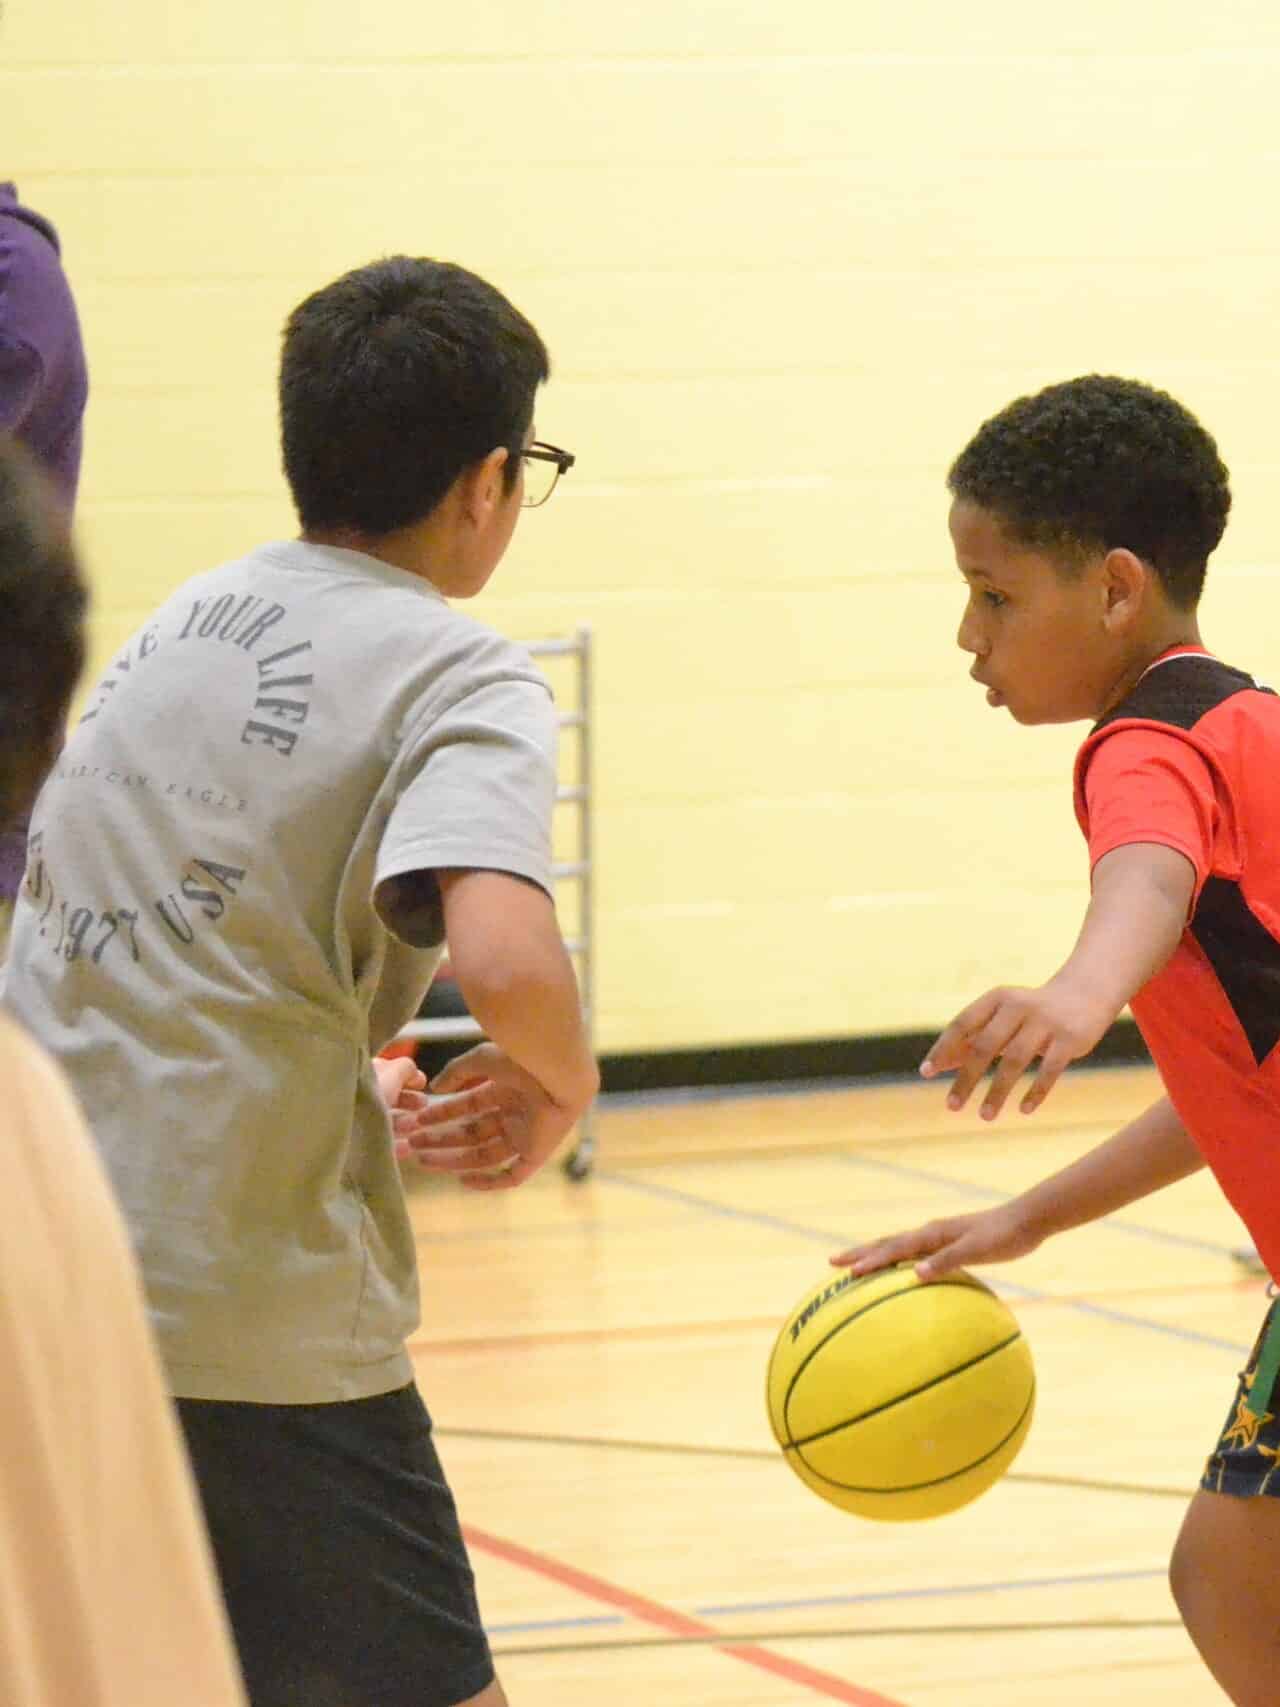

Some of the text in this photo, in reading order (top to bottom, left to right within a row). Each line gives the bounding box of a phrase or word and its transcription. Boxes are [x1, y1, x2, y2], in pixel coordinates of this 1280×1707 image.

[178, 592, 287, 651] YOUR
[240, 640, 314, 757] LIFE
[156, 858, 247, 944] USA
